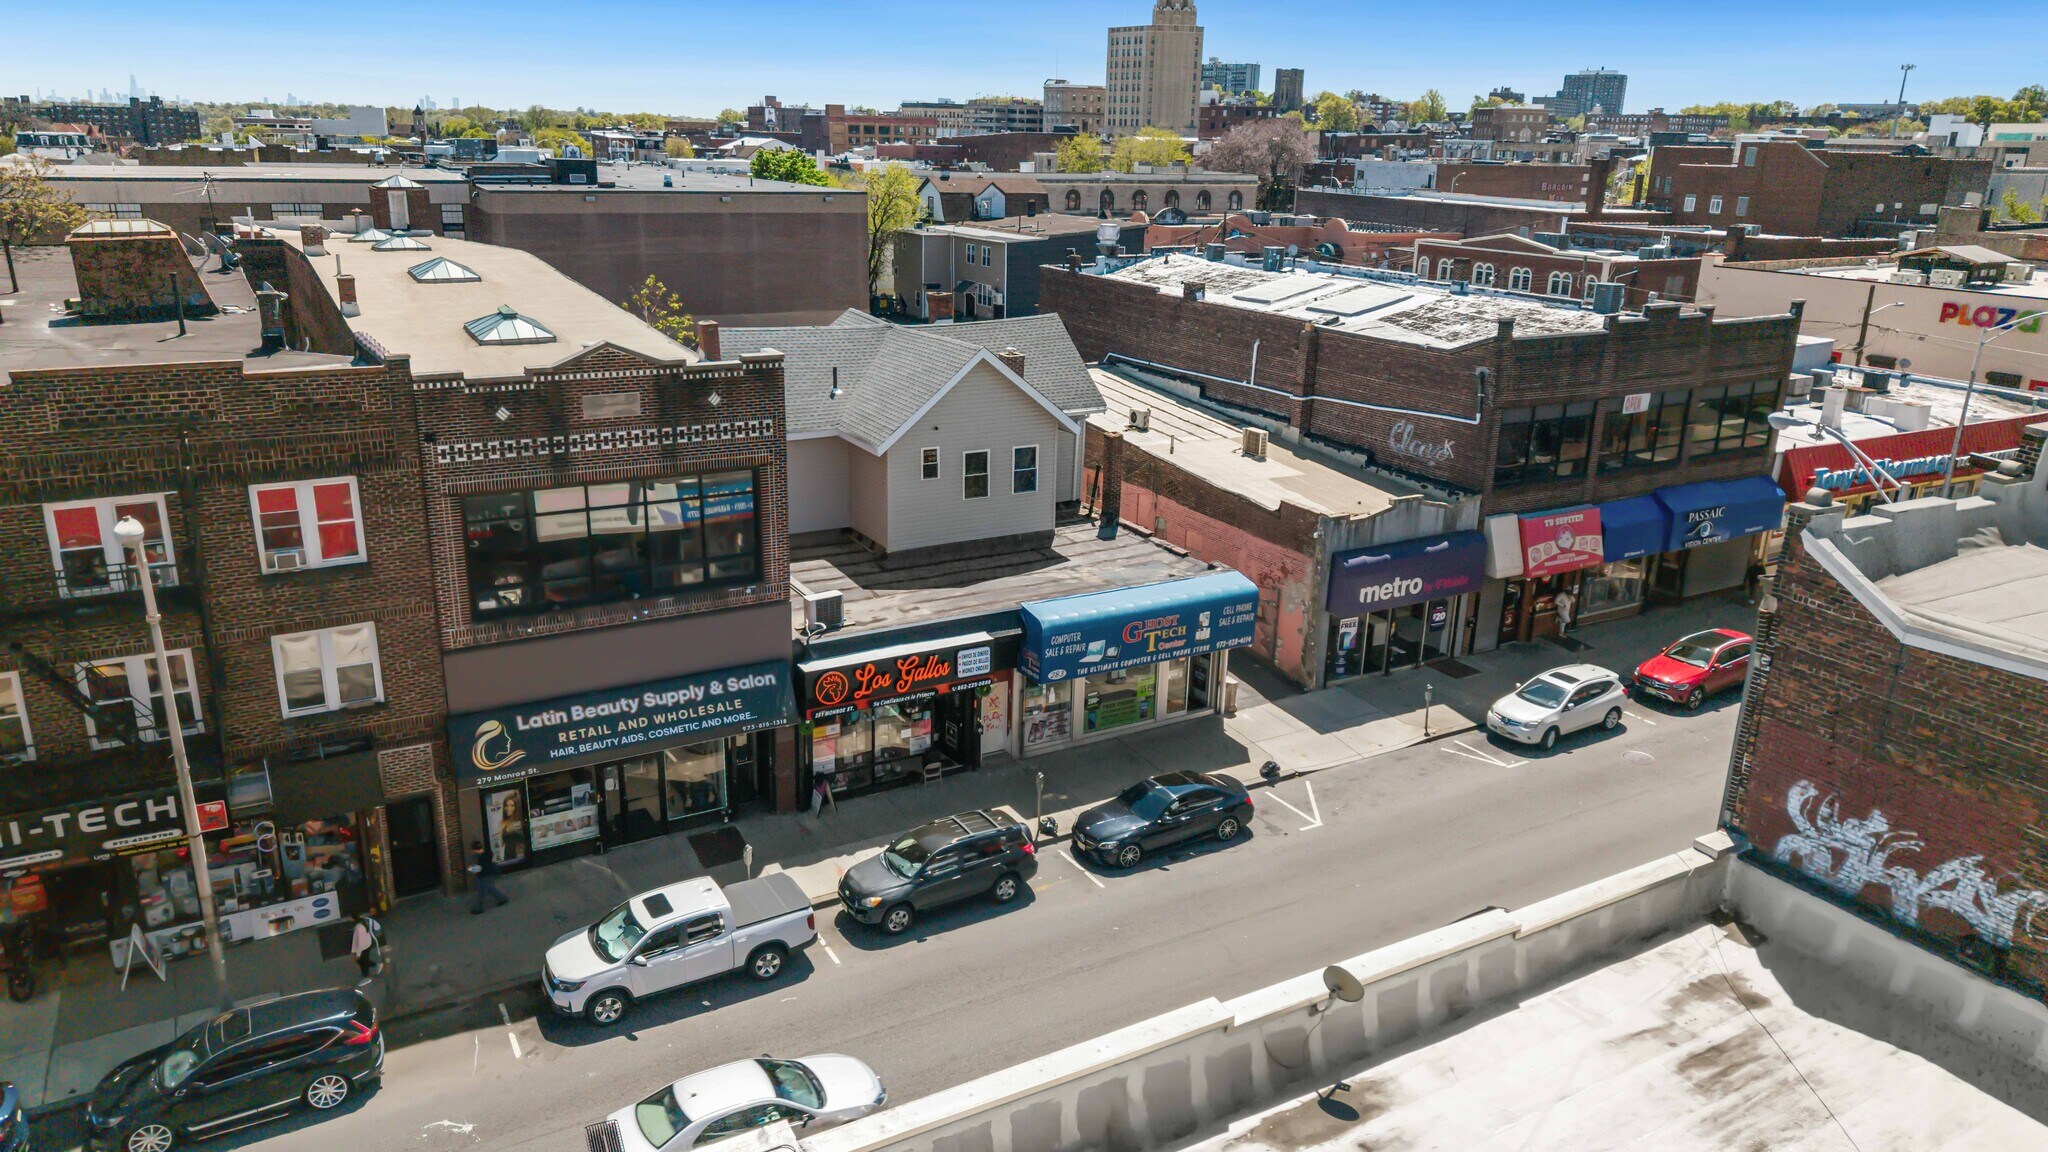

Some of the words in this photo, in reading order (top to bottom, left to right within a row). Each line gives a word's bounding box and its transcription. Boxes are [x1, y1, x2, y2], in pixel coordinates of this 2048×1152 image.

[1814, 462, 1867, 490] Tony's
[1688, 506, 1725, 523] PASSAIC
[1360, 577, 1422, 604] metro
[1219, 616, 1231, 627] SALE
[1236, 612, 1254, 623] REPAIR
[1223, 605, 1235, 615] CELL
[1236, 602, 1253, 613] PHONE
[1045, 647, 1059, 658] SALE
[1065, 643, 1087, 655] REPAIR
[1051, 632, 1081, 645] COMPUTER
[1077, 667, 1088, 675] THE
[1090, 661, 1118, 673] ULTIMATE
[1120, 655, 1151, 667] COMPUTER
[1172, 648, 1191, 657] PHONE
[1192, 644, 1210, 653] STORE
[854, 663, 892, 699] Los
[896, 655, 950, 693] Gallos
[516, 710, 568, 731] Latin
[570, 697, 639, 721] Beauty
[643, 684, 704, 707] Supply
[709, 680, 723, 695] &
[726, 674, 776, 692] Salon
[558, 724, 611, 742] RETAIL
[618, 717, 648, 731] AND
[653, 699, 743, 724] WHOLESALE
[550, 746, 577, 758] HAIR,
[579, 738, 619, 752] BEAUTY
[621, 732, 647, 744] AIDS,
[649, 722, 699, 738] COSMETIC
[701, 717, 721, 728] AND
[477, 776, 491, 785] 279
[494, 769, 526, 781] Monroe
[0, 796, 178, 848] I-TECH
